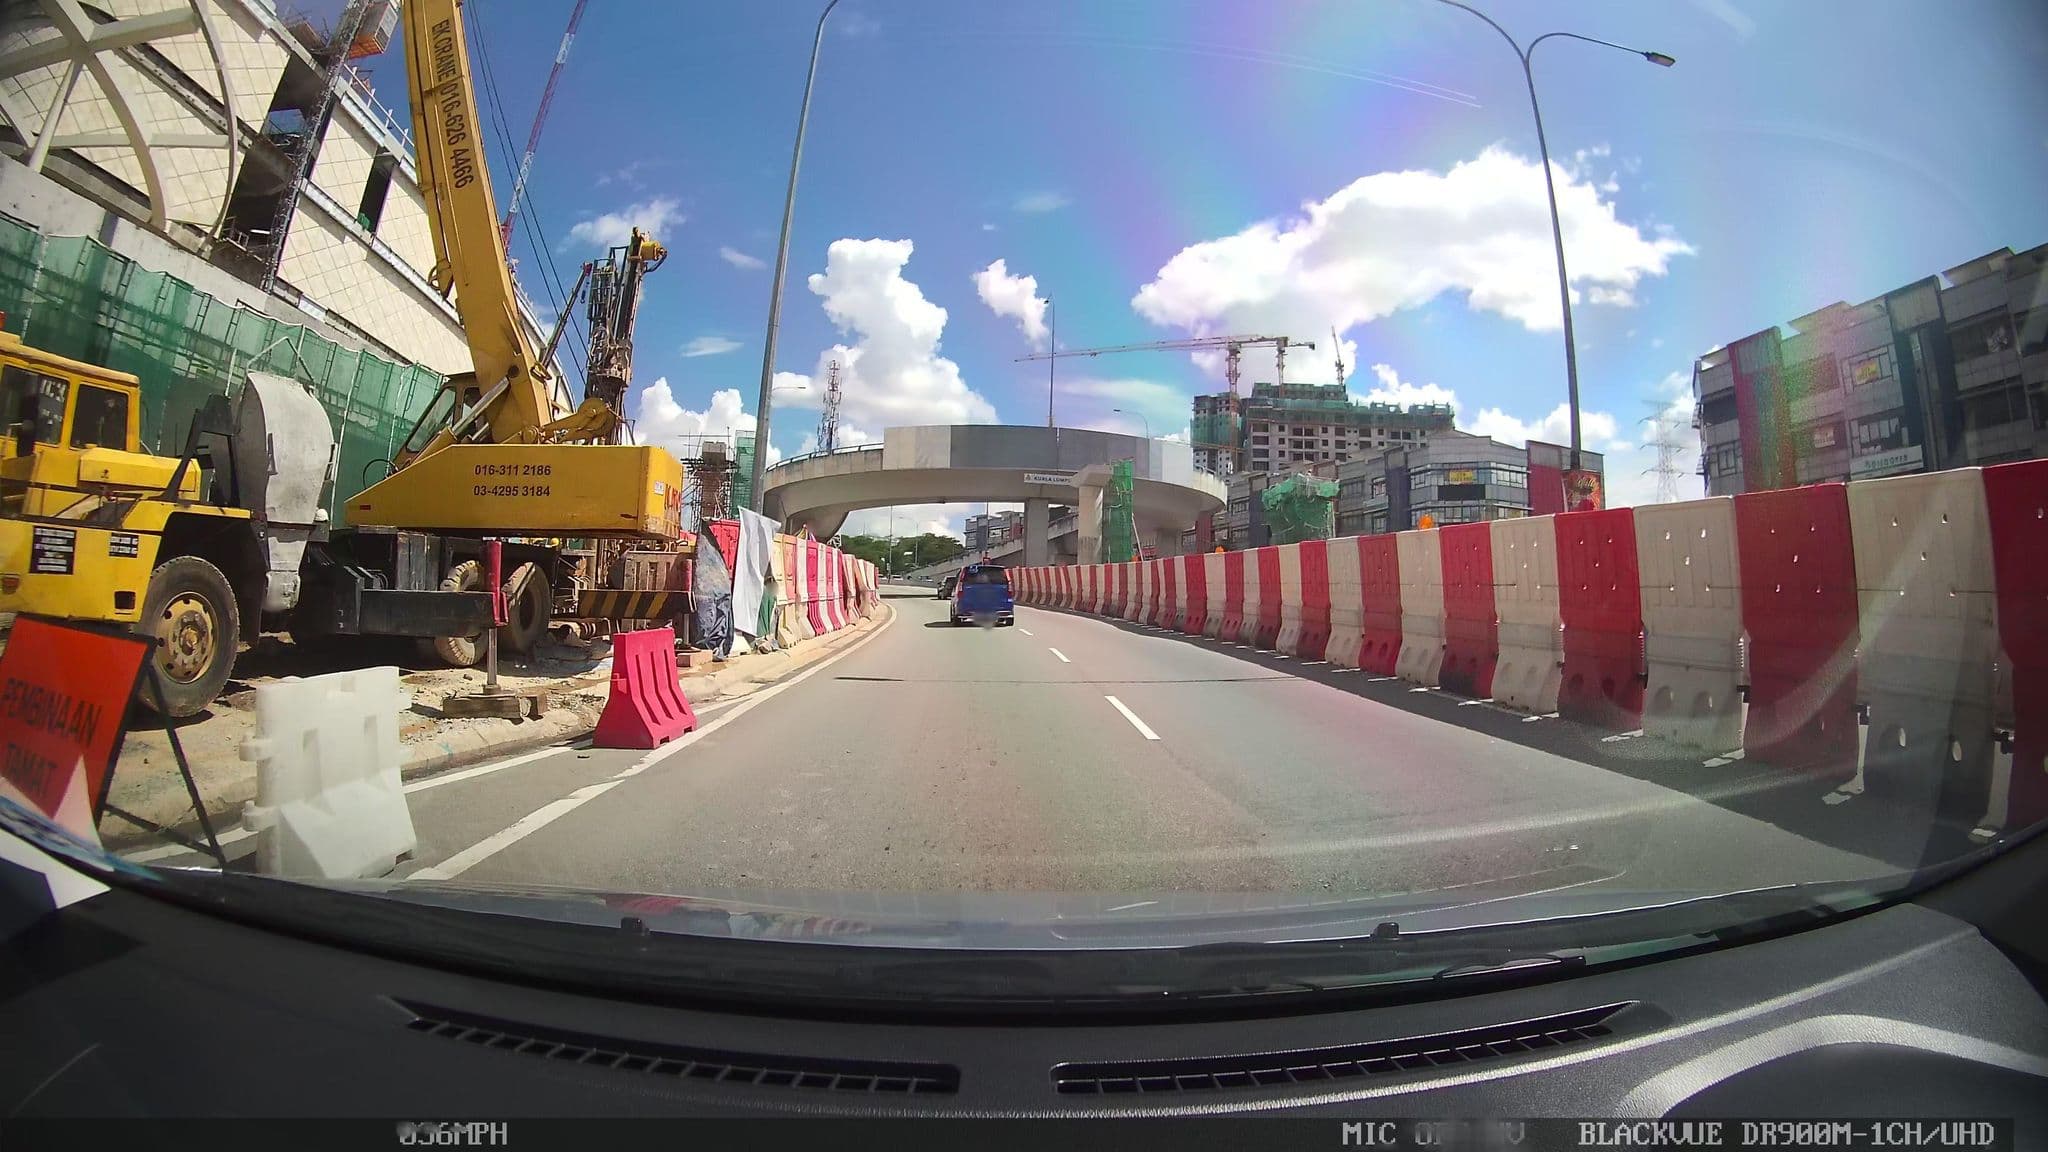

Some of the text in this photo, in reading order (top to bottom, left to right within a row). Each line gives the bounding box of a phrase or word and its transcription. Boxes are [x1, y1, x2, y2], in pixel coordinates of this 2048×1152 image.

[432, 19, 474, 189] EK CRANE 016-626 4466
[474, 464, 552, 476] 016-311 2186
[473, 485, 550, 497] 03-4295 3184
[2, 677, 103, 748] PEMBINAAN
